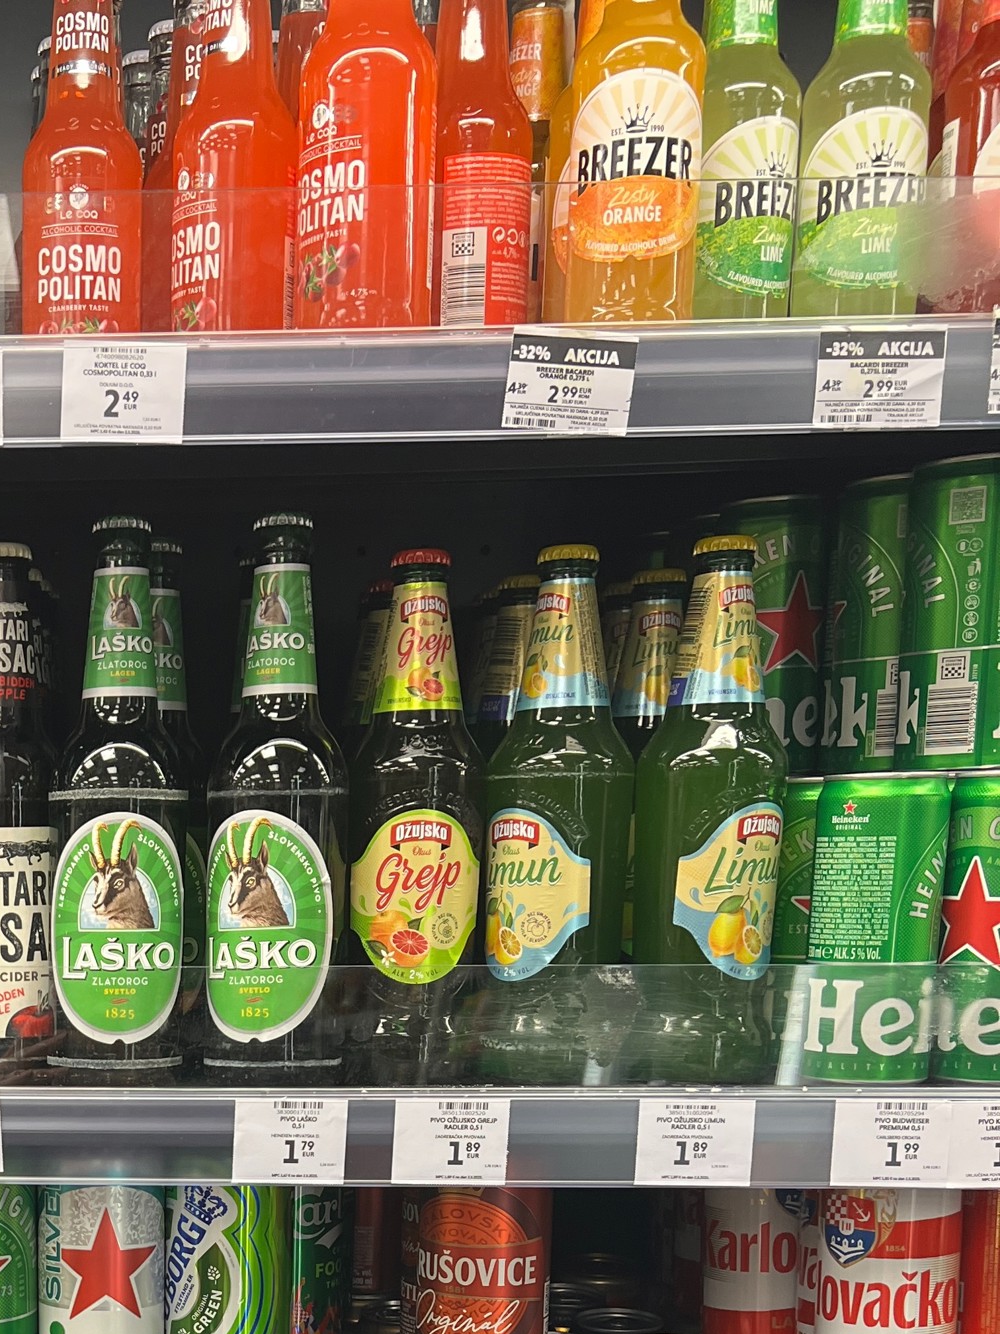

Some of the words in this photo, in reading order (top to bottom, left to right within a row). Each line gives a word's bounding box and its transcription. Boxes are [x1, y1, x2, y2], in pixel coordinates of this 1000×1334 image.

[57, 12, 108, 35] COSMO
[56, 32, 108, 53] POLITAN
[578, 137, 692, 197] BREEZER
[608, 187, 660, 209] Zesty
[604, 207, 661, 226] ORANGE
[42, 226, 81, 235] ALCOHOLIC
[84, 225, 117, 236] COCKTAIL
[585, 240, 616, 252] FLAVOURED
[618, 238, 655, 251] ALCOHOLIC
[657, 235, 676, 247] DRINK
[761, 244, 783, 263] LIME
[38, 244, 121, 275] COSMO
[38, 276, 120, 303] POLITAN
[514, 345, 550, 360] -32%
[564, 348, 620, 365] AKCIJA
[826, 343, 864, 356] -32%
[878, 341, 934, 356] AKCIJA
[566, 368, 594, 376] BACARDI
[548, 386, 558, 403] 2
[562, 386, 578, 398] 99
[92, 630, 152, 660] LAŠKO
[397, 627, 452, 669] Grejp
[98, 660, 147, 670] ZLATOROG
[832, 814, 870, 824] Heineken
[396, 822, 447, 842] Ožujsko
[494, 822, 535, 841] Ožujsko
[138, 833, 175, 879] SLOVENSKO
[169, 881, 179, 907] PIVO
[376, 853, 461, 913] Grejp
[62, 937, 175, 980] LAŠKO
[0, 971, 38, 982] CIDER
[92, 976, 148, 986] ZLATOROG
[105, 1008, 134, 1018] 1825
[283, 1140, 298, 1163] 1
[302, 1142, 314, 1150] 79
[448, 1142, 463, 1165] 1
[466, 1143, 480, 1152] 89
[885, 1142, 901, 1166] 1
[905, 1143, 919, 1153] 99
